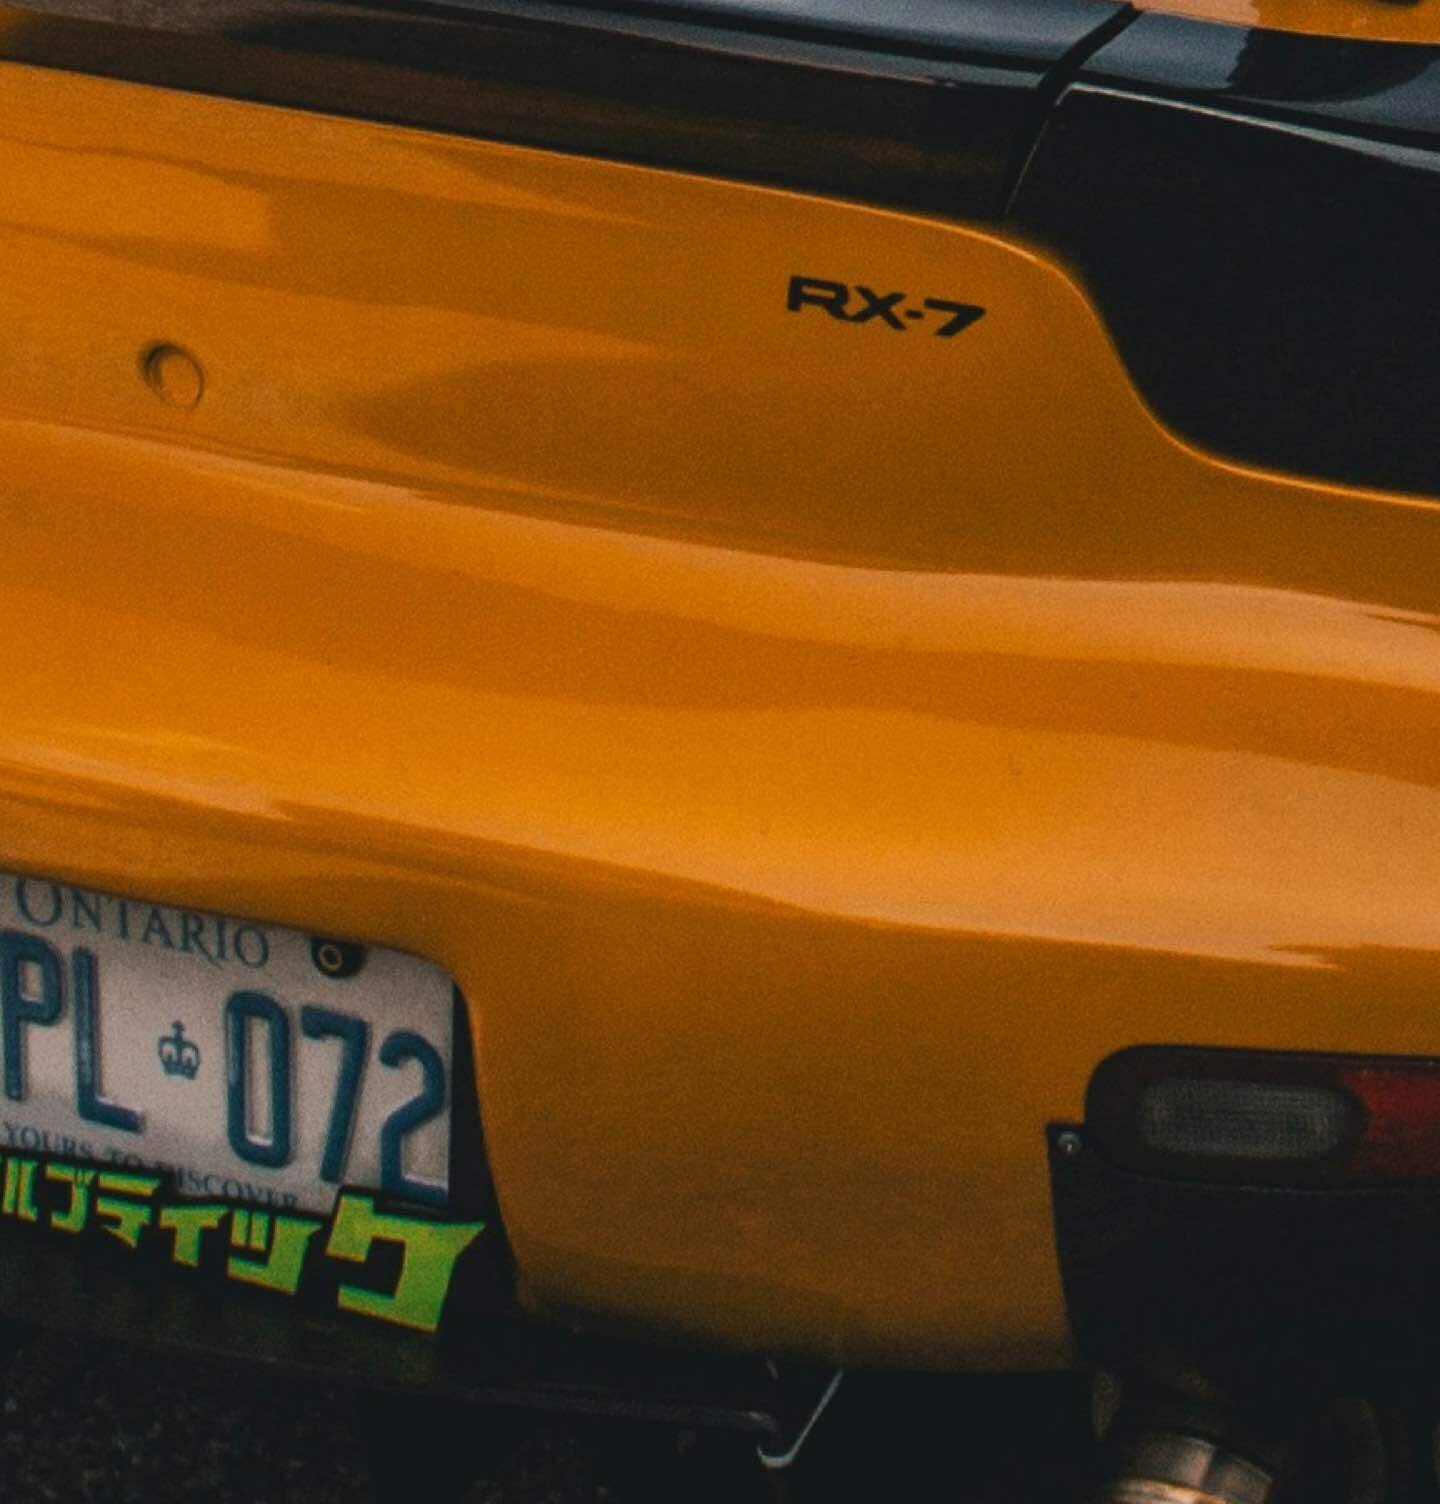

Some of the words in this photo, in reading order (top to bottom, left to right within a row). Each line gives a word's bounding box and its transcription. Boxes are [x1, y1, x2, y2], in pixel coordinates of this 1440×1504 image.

[787, 276, 986, 336] RX-7
[14, 875, 270, 971] ONTARIO
[225, 990, 448, 1210] 072
